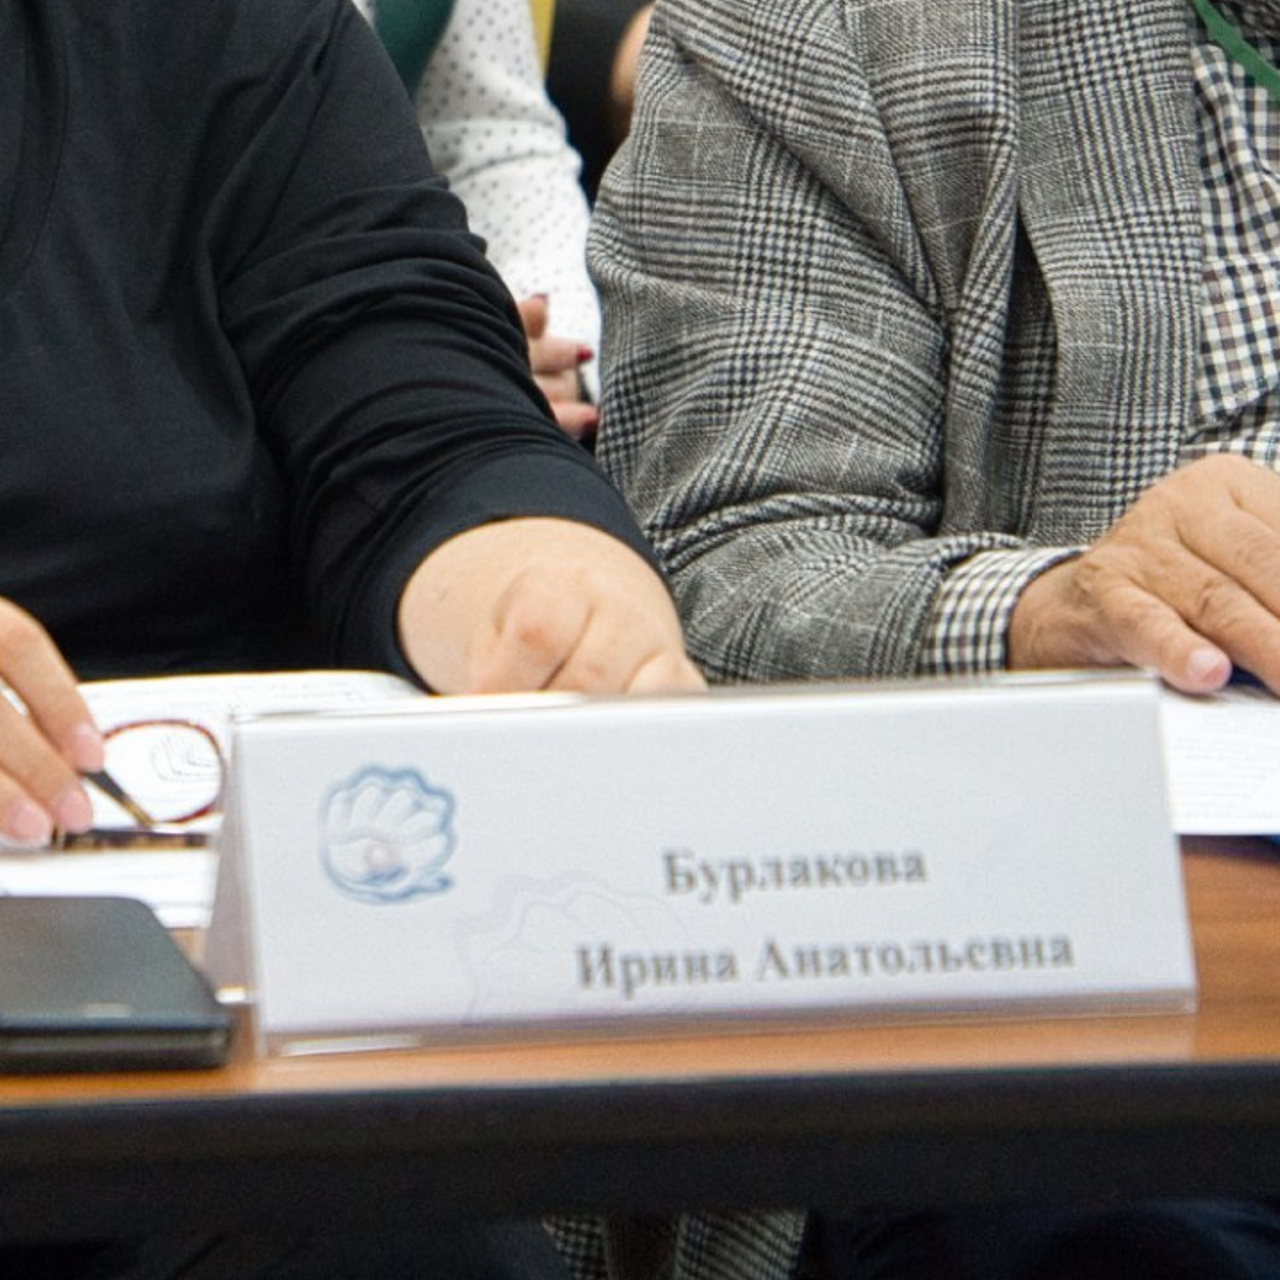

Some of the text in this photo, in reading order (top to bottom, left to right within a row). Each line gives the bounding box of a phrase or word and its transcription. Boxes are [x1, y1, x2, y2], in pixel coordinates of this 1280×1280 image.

[662, 848, 928, 904] Бурлакова
[576, 932, 1076, 1000] Ирина Анатольевна
